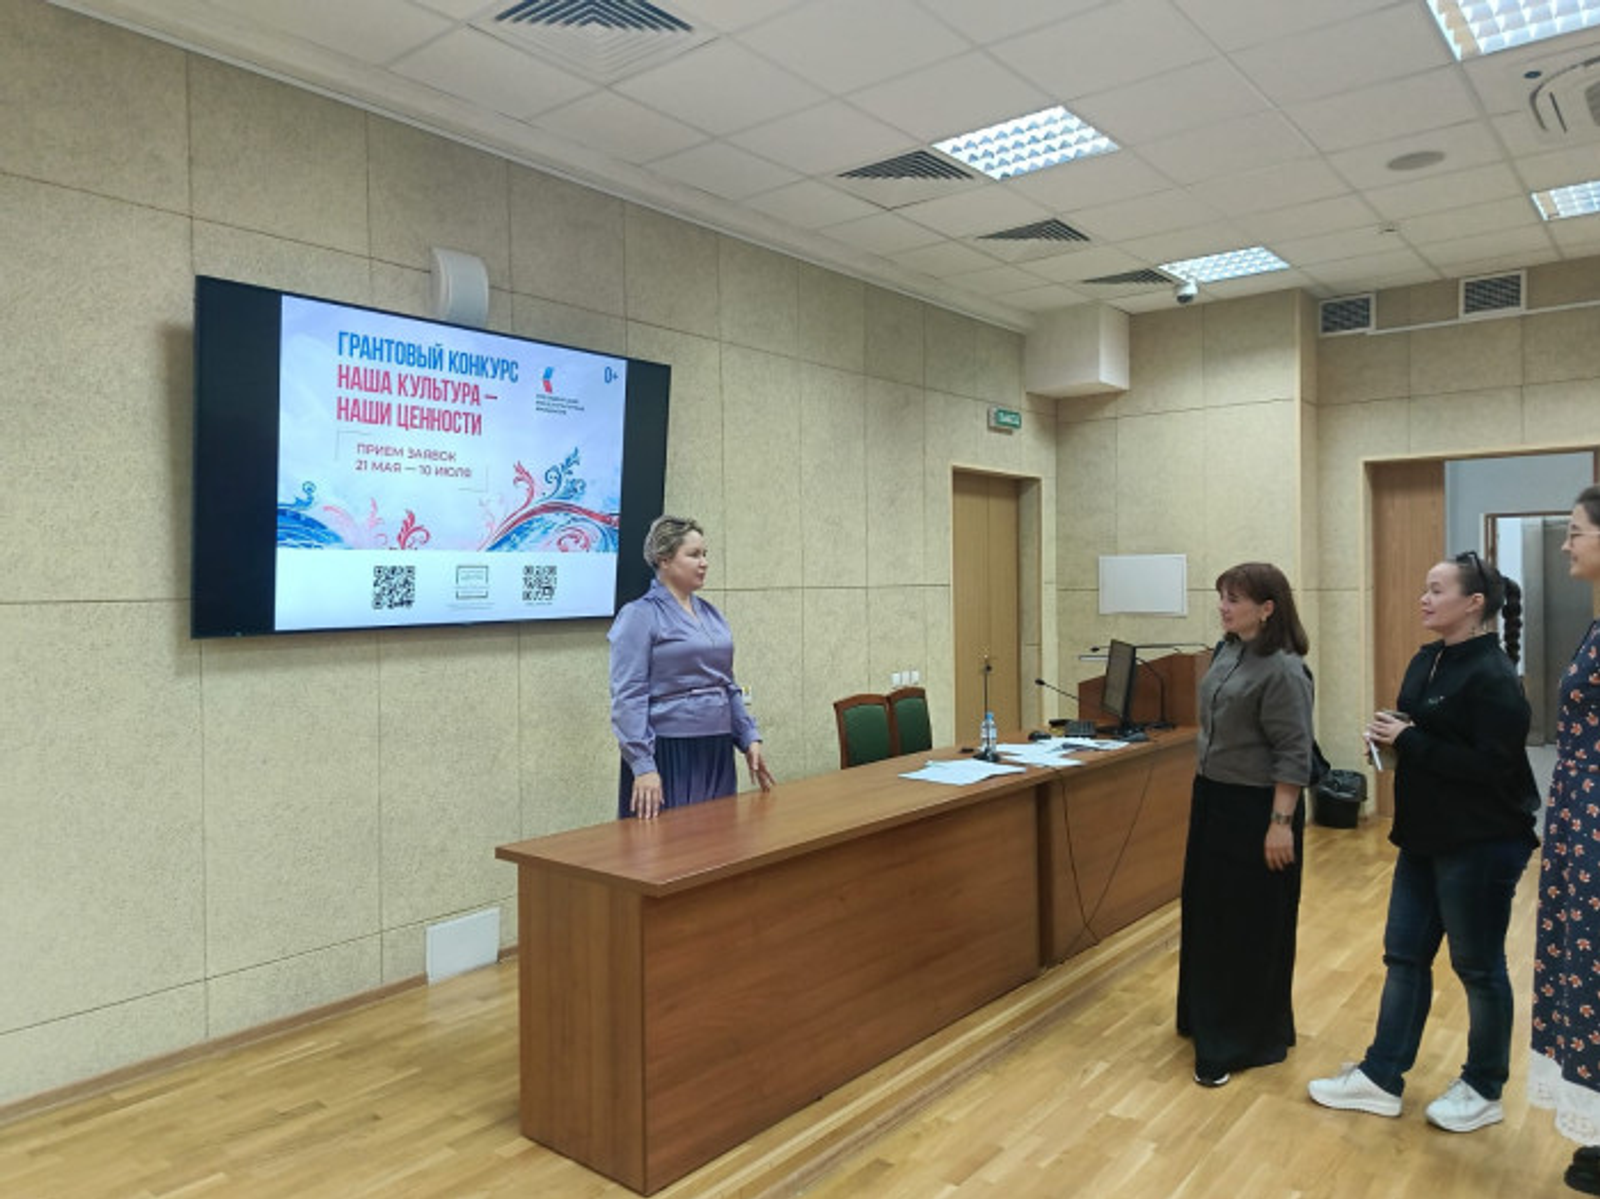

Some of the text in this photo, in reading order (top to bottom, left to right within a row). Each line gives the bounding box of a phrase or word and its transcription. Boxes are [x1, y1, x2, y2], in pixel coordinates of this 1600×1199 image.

[338, 331, 519, 383] ГРАНТОВЫЙ КОНКУРС
[337, 364, 393, 395] НАША
[397, 372, 481, 406] КУЛЬТУРА
[604, 366, 618, 384] 0+
[336, 396, 482, 436] НАШИ ЦЕННОСТИ
[355, 460, 368, 471] 21
[371, 462, 401, 473] МАЯ
[419, 465, 431, 476] 10
[434, 467, 472, 478] ИЮЛЯ
[407, 447, 457, 462] ЗАЯВОК
